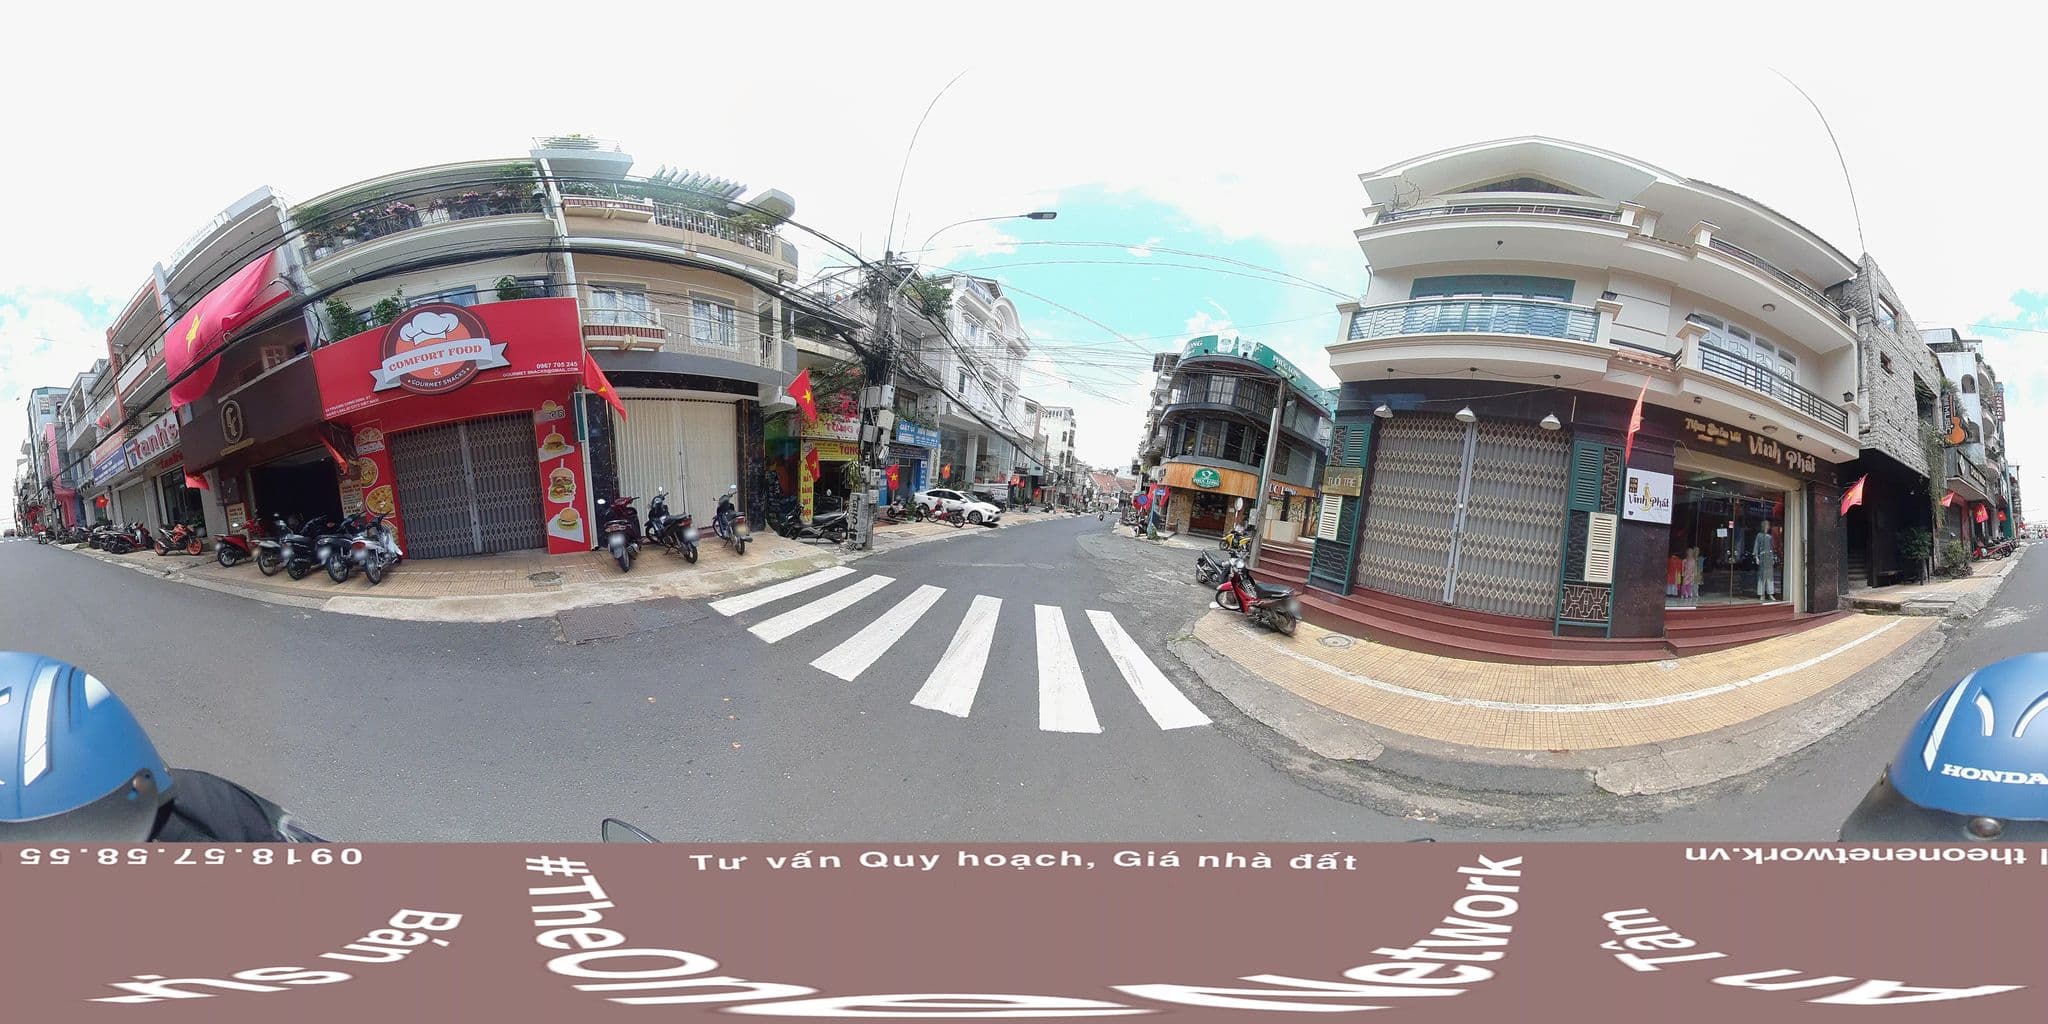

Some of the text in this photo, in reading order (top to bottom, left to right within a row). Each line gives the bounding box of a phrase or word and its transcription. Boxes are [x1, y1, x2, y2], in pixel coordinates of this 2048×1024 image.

[389, 345, 482, 371] COMFORT FOOD
[411, 369, 466, 387] GOURMET SNACKS
[433, 367, 441, 376] &
[1628, 493, 1648, 507] Vĩnh
[1941, 763, 2048, 785] HONDA
